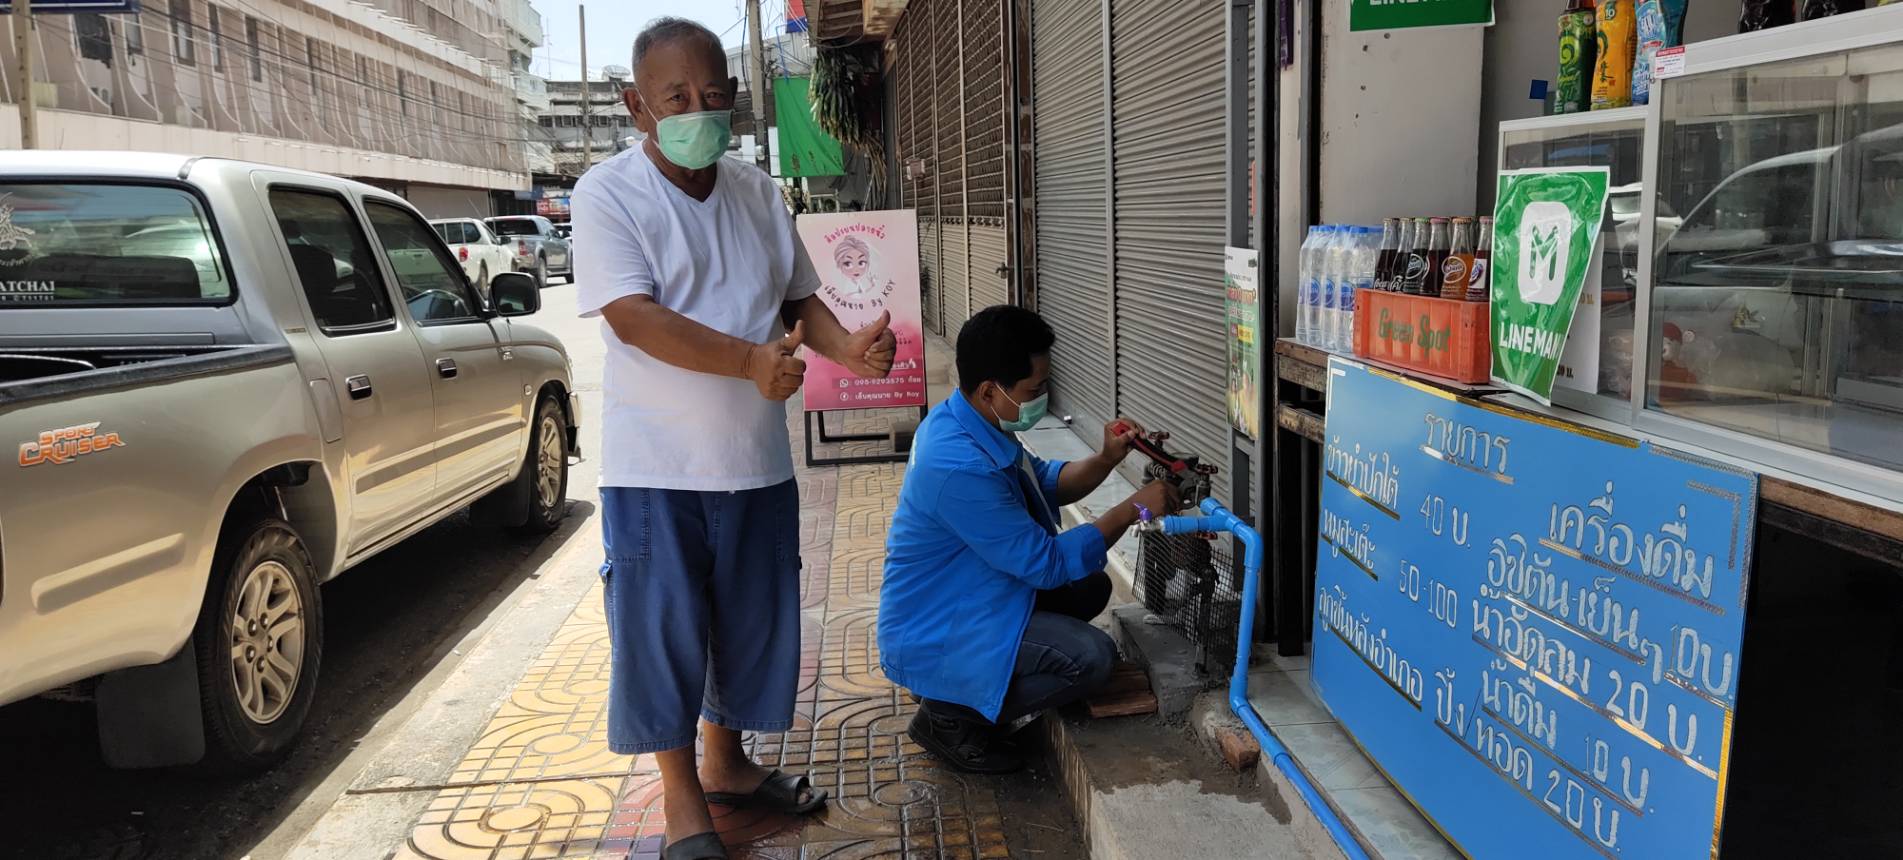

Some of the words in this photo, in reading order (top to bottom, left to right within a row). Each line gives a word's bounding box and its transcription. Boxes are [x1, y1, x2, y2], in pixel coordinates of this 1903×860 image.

[871, 298, 883, 307] By
[1379, 307, 1414, 345] Green
[1418, 313, 1451, 358] Spot
[19, 432, 126, 467] CRUISER
[39, 421, 101, 446] SPORT
[1425, 413, 1511, 474] รายการ
[1324, 508, 1376, 569] หมูสะเต๊ะ
[1420, 495, 1444, 536] 40
[1549, 480, 1714, 599] เครื่องดื่ม
[1472, 584, 1591, 695] น้ำอัดลม
[1606, 669, 1649, 730] 20
[1482, 658, 1558, 750] น้ำดื่ม
[1583, 736, 1609, 783] 10
